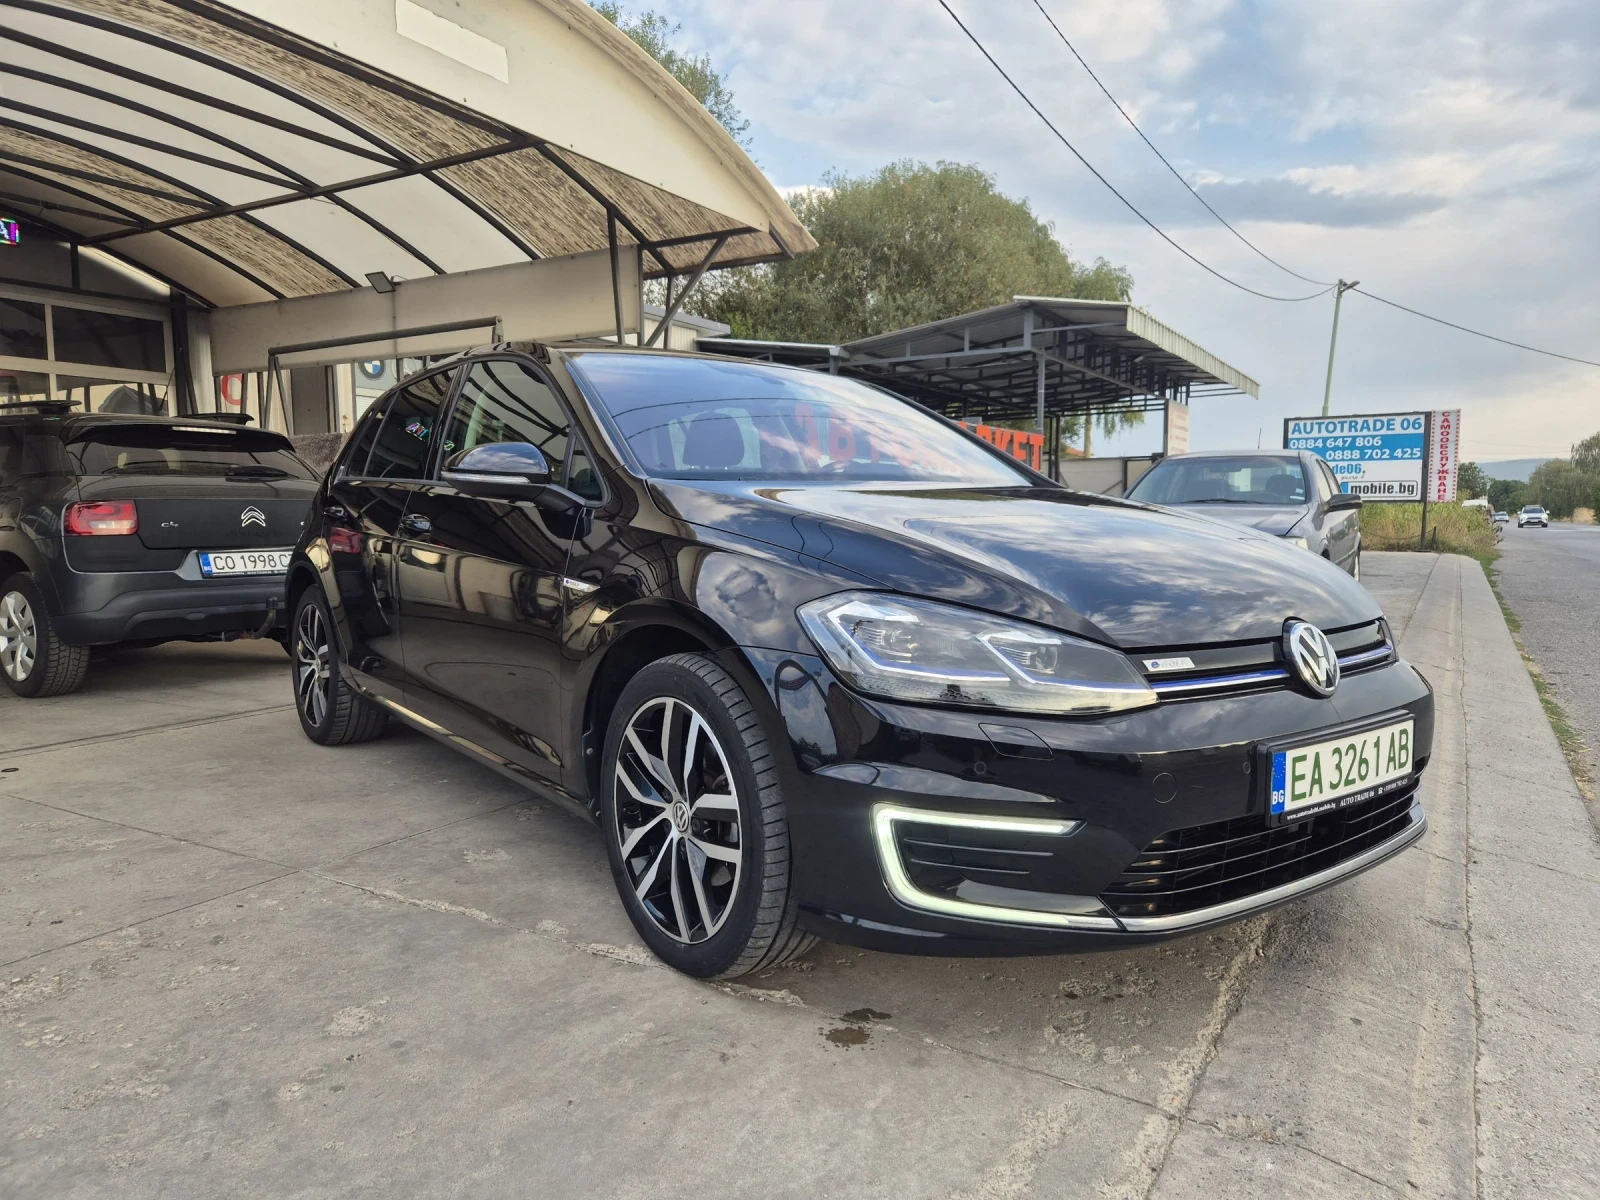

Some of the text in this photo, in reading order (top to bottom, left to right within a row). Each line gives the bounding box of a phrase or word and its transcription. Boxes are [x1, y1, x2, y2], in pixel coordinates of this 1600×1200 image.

[1291, 417, 1422, 435] AUTOTRADE 06
[1289, 436, 1382, 449] 0884 647 806
[1326, 447, 1421, 460] 0888 702 425
[1437, 411, 1451, 500] САМООБСЛУЖВАНЕ
[1350, 481, 1415, 496] mobile.bg
[213, 555, 236, 571] CO
[240, 554, 277, 569] 1998
[1290, 728, 1409, 802] EA 3261 AB
[1272, 789, 1285, 805] BG
[1339, 797, 1355, 808] AUTO
